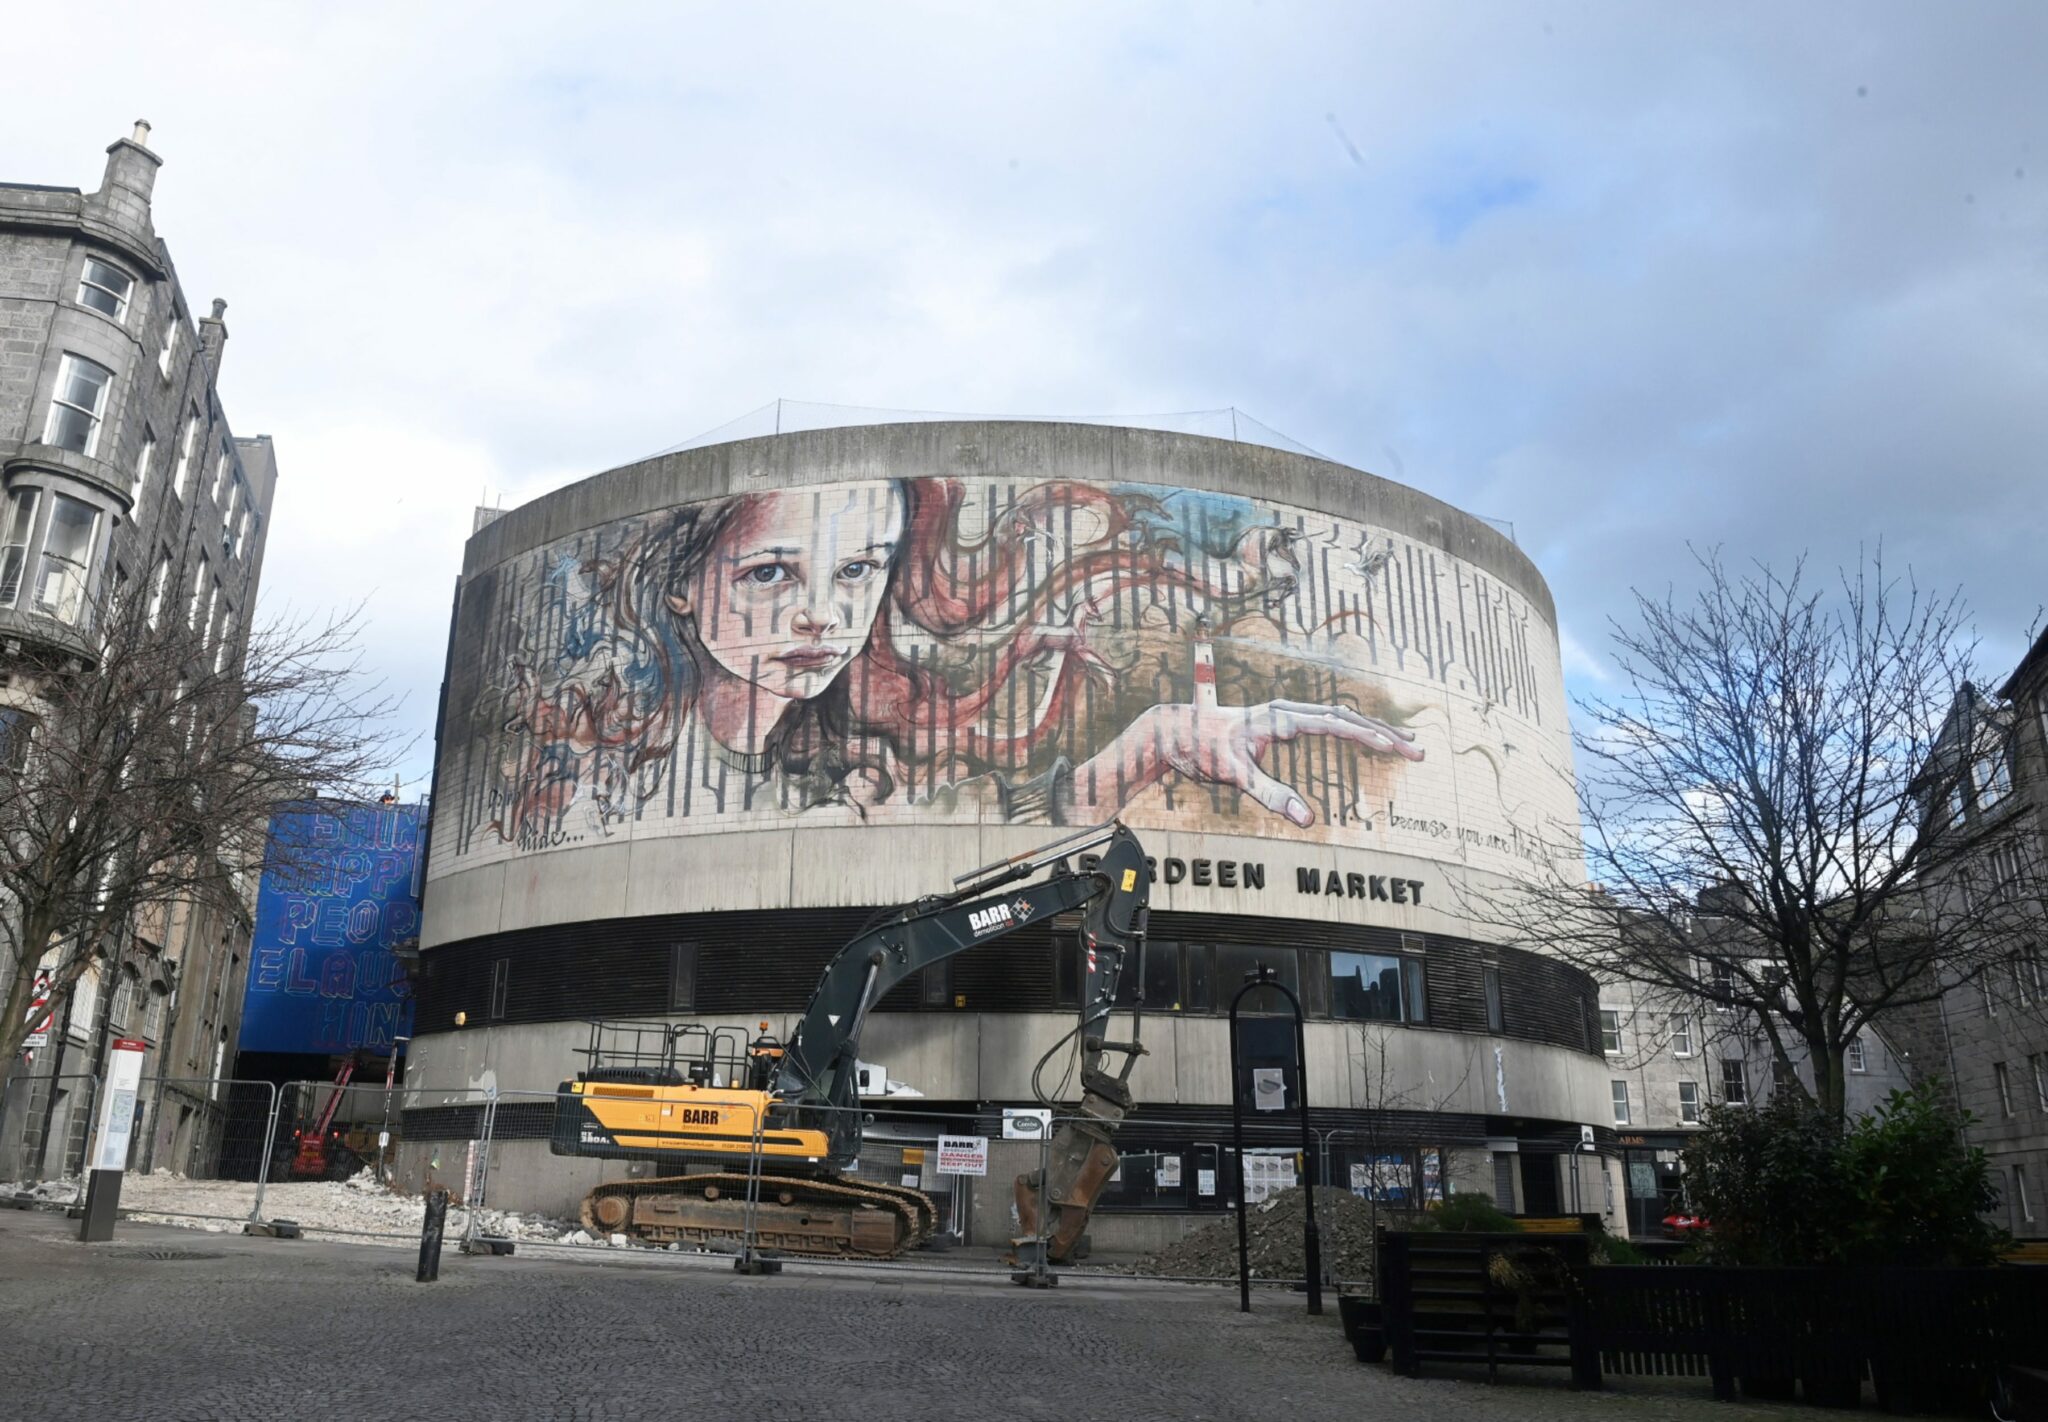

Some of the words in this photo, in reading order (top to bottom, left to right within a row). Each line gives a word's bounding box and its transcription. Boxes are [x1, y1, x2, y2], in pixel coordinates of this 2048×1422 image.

[1457, 826, 1484, 862] you
[1048, 852, 1266, 890] ABRDEEN
[1297, 866, 1425, 906] MARKET
[968, 903, 1012, 931] BARR
[682, 1109, 719, 1125] BARR
[943, 1141, 974, 1149] BARR
